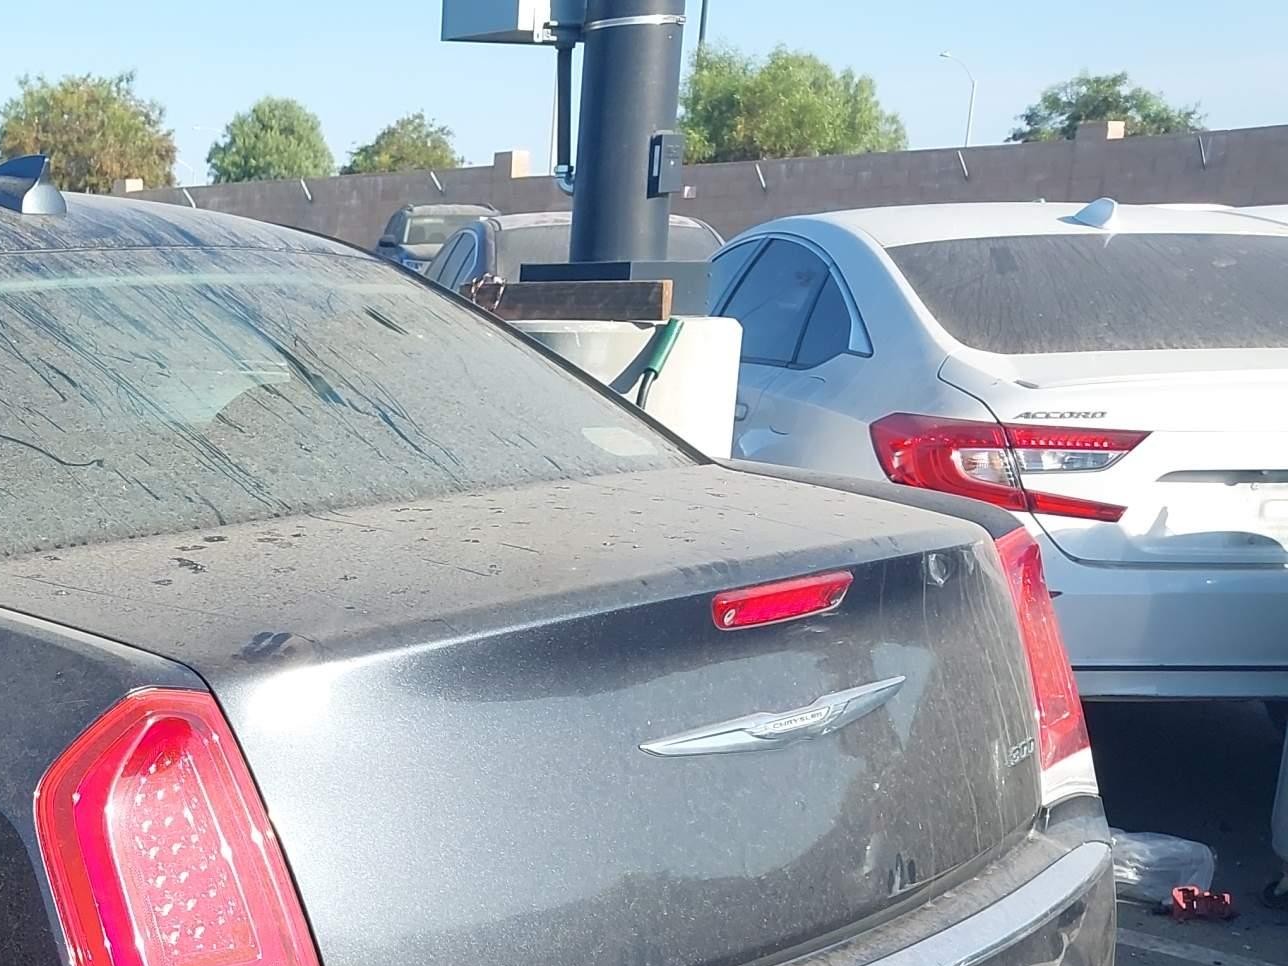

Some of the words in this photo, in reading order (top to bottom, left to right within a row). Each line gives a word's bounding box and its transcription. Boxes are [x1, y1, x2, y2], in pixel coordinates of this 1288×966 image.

[1013, 411, 1107, 420] ACCORD
[772, 711, 823, 730] CHRYSLER
[1005, 736, 1035, 768] 300
